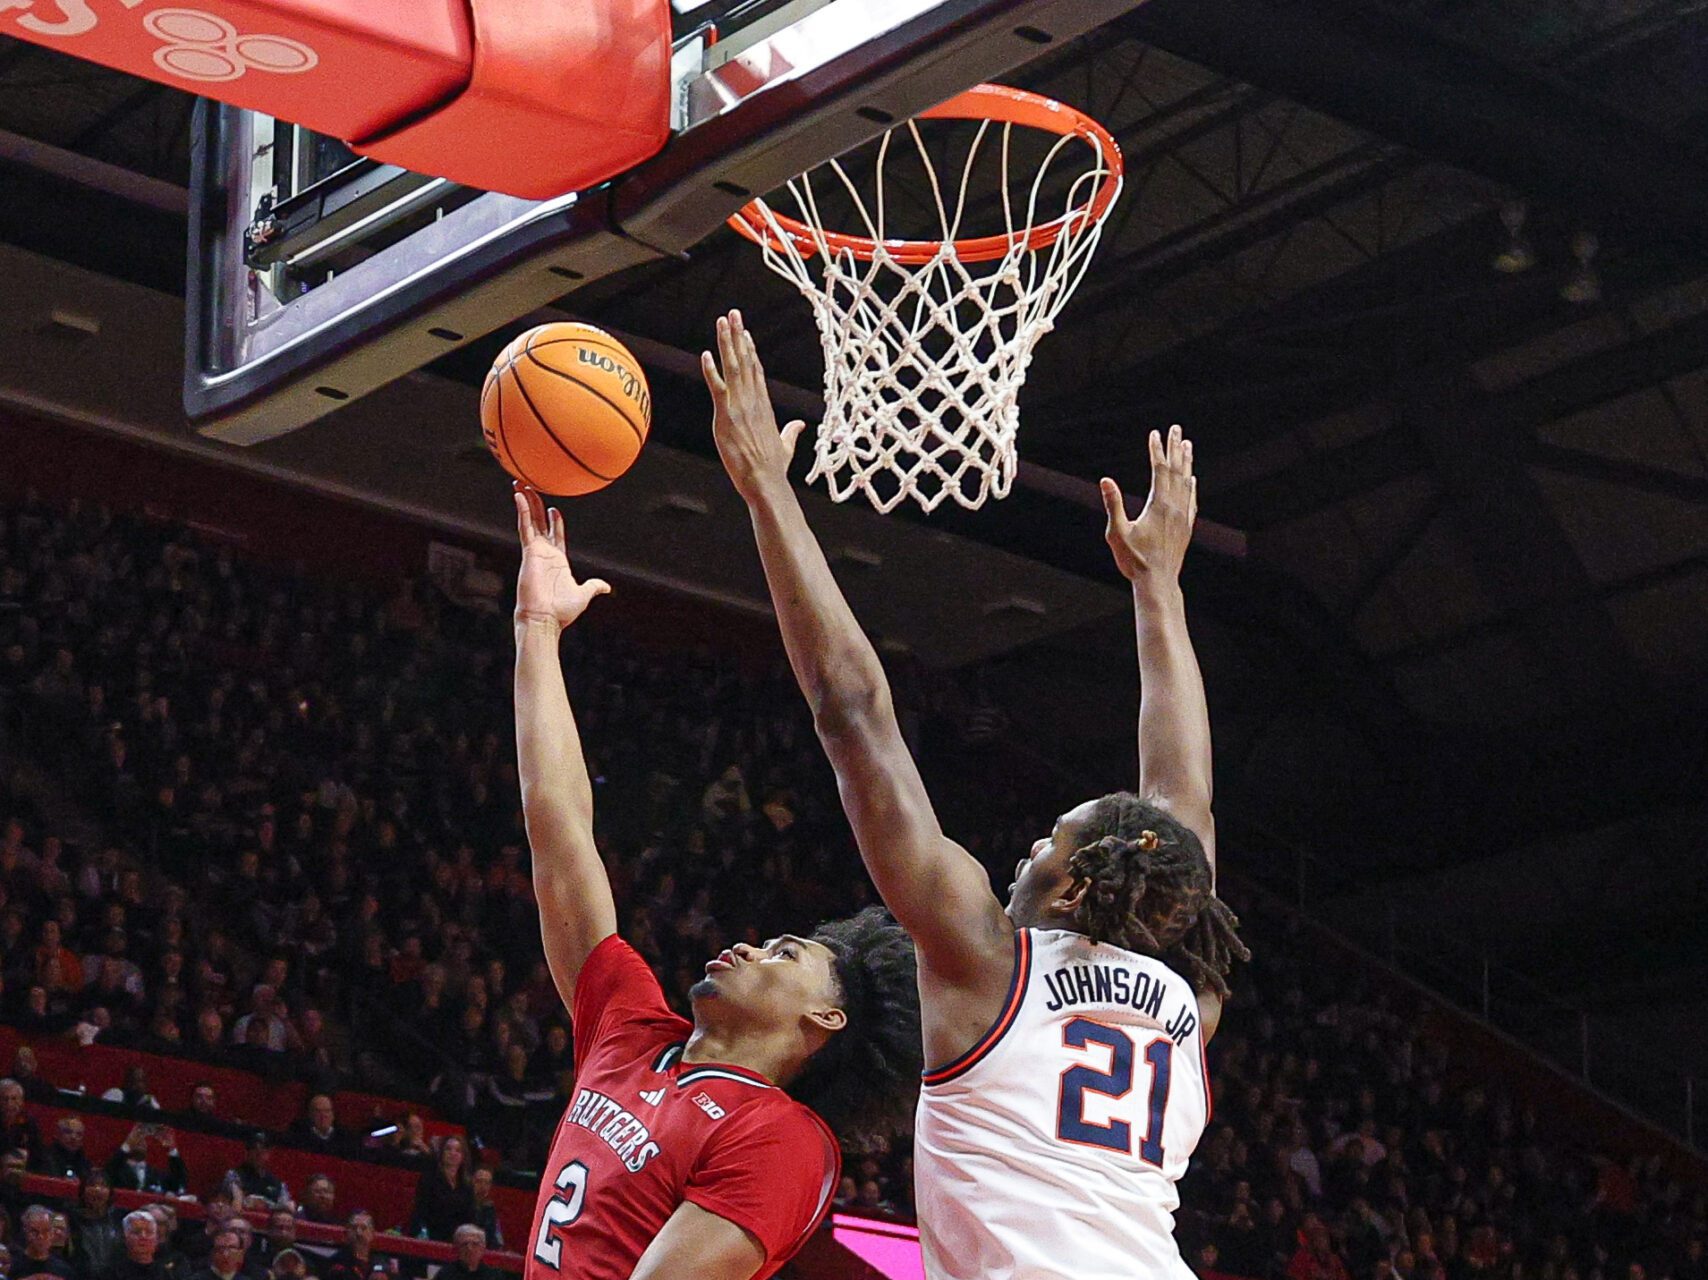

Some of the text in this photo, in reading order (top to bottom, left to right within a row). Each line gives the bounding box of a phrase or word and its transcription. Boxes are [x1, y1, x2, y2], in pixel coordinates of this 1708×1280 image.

[1045, 965, 1196, 1047] JOHNSON JR
[567, 1089, 660, 1173] RUTGERS
[1055, 1015, 1174, 1169] 21
[535, 1158, 590, 1271] 2
